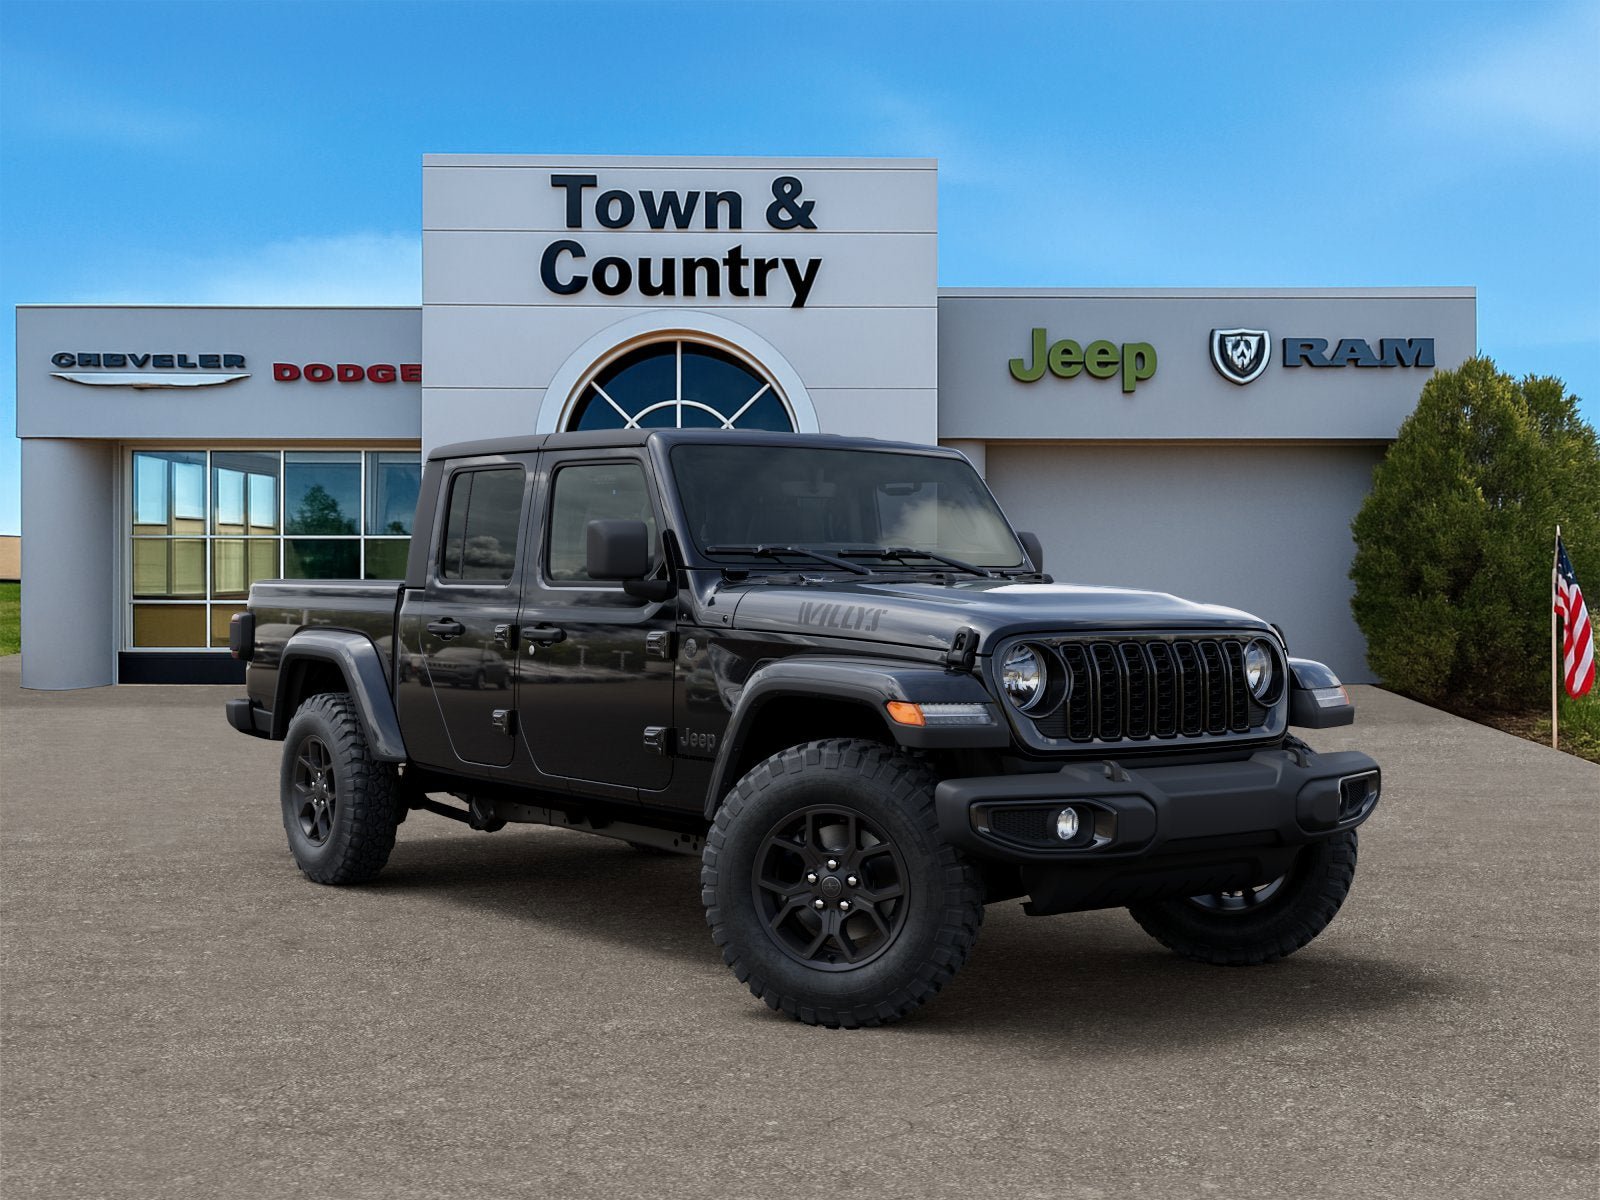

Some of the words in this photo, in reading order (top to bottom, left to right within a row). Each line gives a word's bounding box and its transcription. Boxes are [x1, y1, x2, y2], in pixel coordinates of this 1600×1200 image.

[550, 174, 743, 230] Town
[765, 175, 818, 230] &
[540, 239, 822, 308] Country
[1008, 327, 1158, 393] Jeep
[1282, 337, 1436, 368] RAM
[273, 362, 422, 383] DODGE
[798, 601, 888, 632] WILLYS
[680, 727, 716, 752] Jeep
